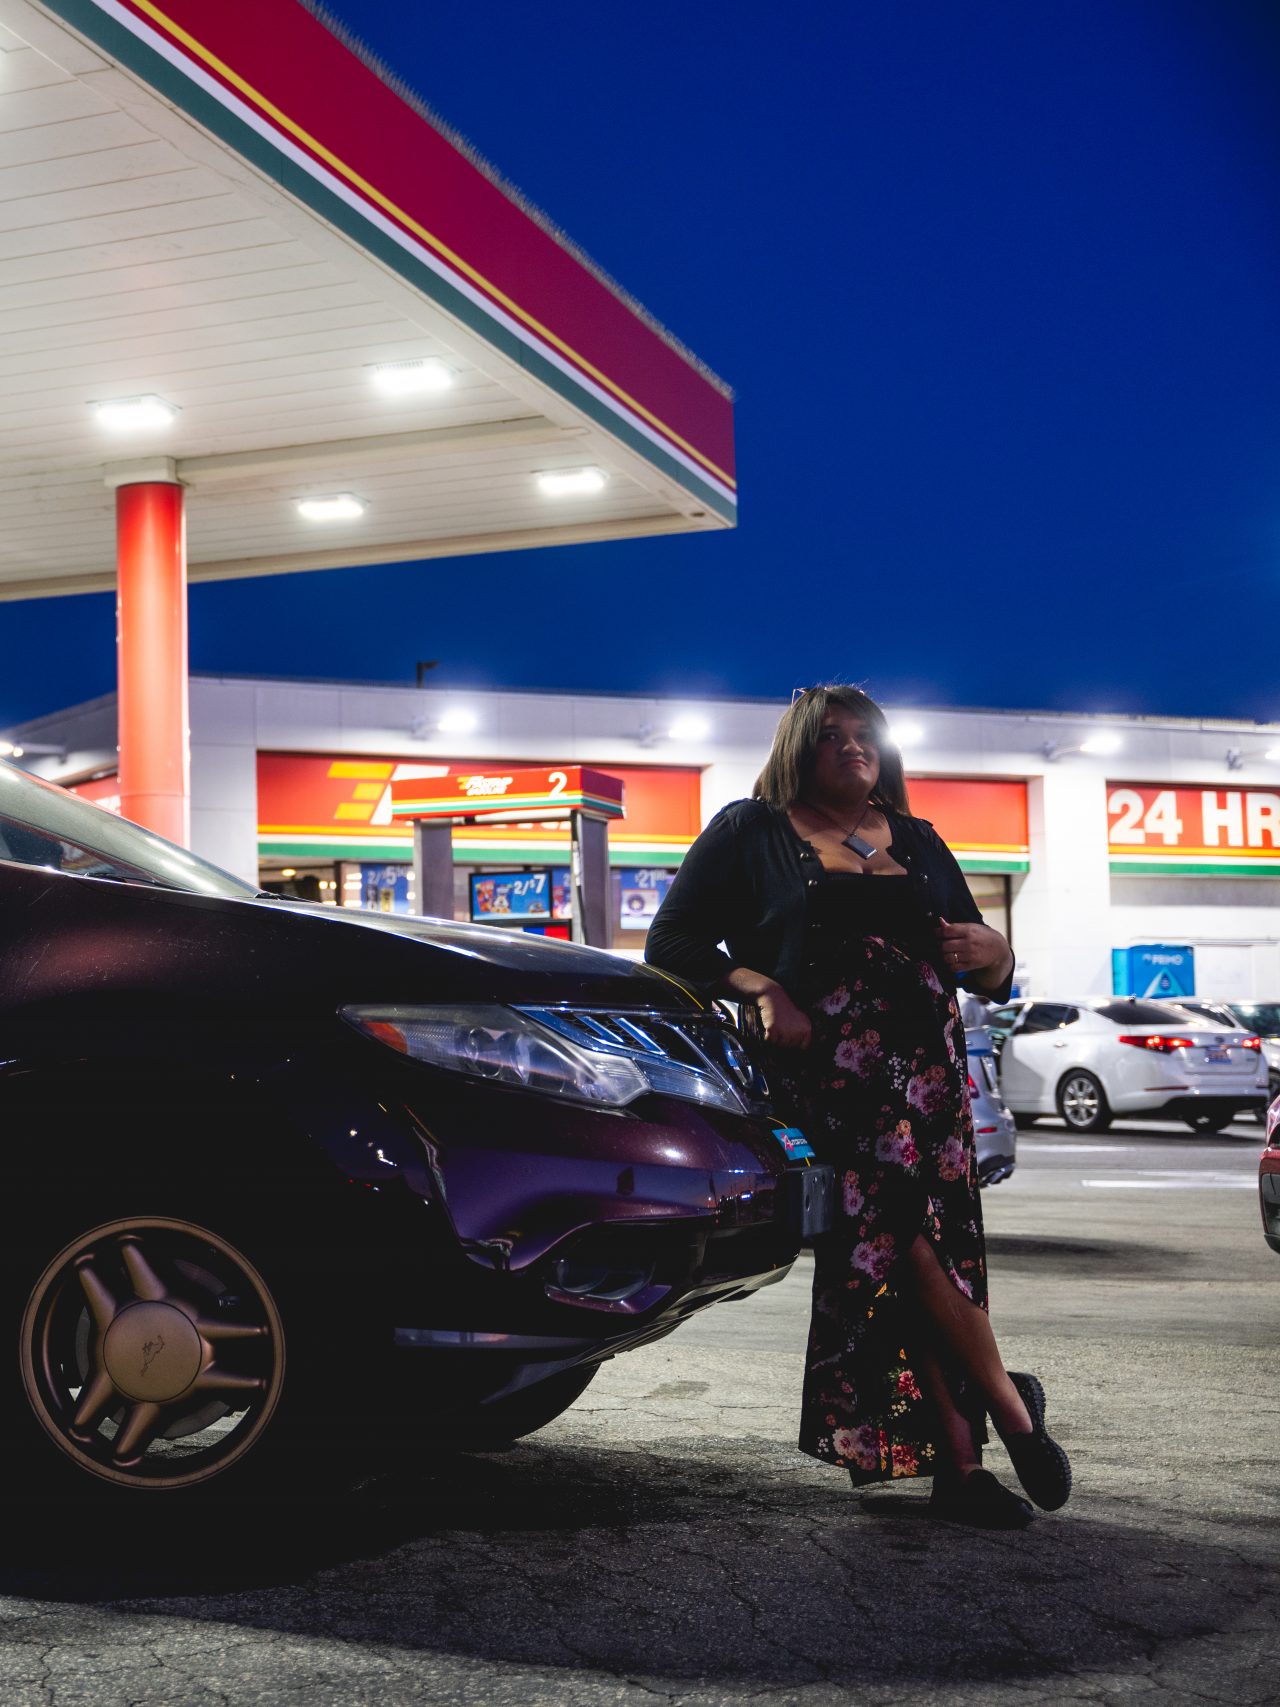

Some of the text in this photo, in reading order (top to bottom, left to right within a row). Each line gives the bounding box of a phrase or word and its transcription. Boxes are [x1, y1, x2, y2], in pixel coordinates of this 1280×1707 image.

[548, 771, 568, 798] 2
[1108, 788, 1183, 845] 24
[513, 874, 546, 896] 2/$7
